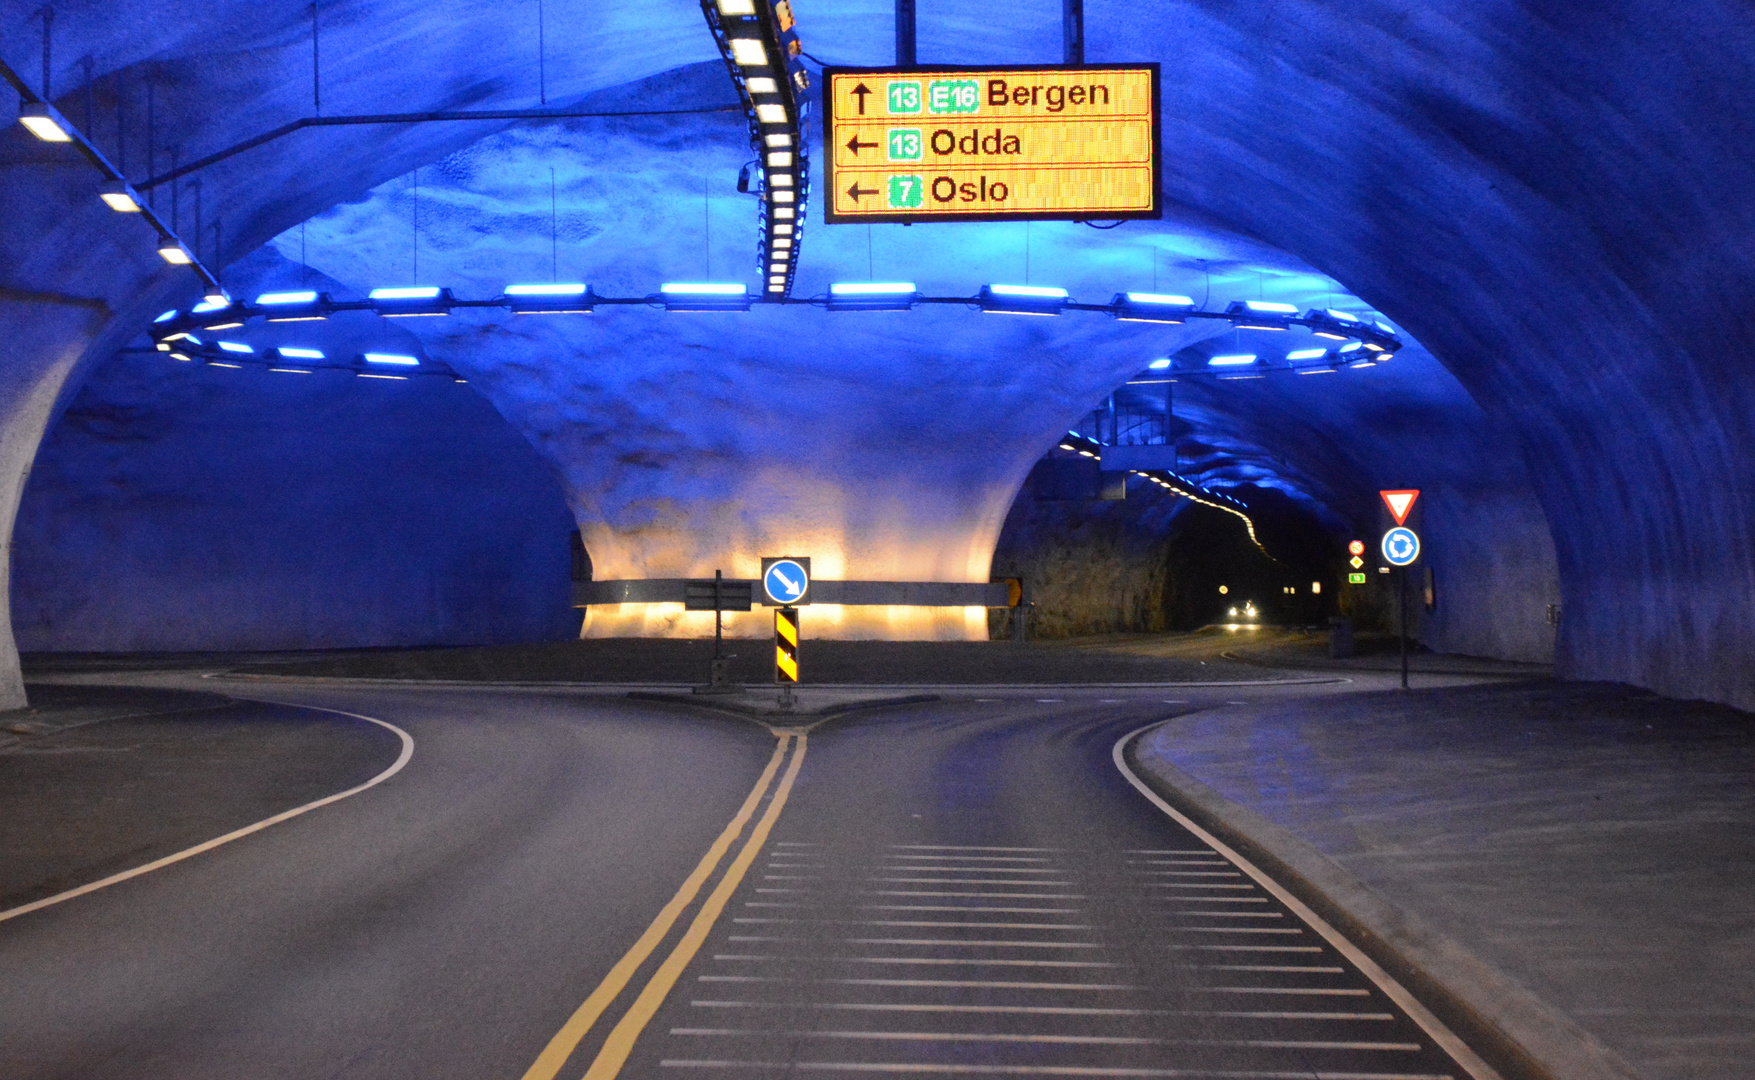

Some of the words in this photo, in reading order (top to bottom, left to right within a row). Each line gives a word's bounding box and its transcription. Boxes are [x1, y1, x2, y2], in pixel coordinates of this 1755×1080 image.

[891, 86, 919, 108] 13
[933, 84, 976, 108] E16
[988, 80, 1109, 112] Bergen
[891, 134, 919, 156] 13
[931, 129, 1021, 155] Odda
[899, 180, 913, 200] 7
[931, 176, 1009, 202] Oslo
